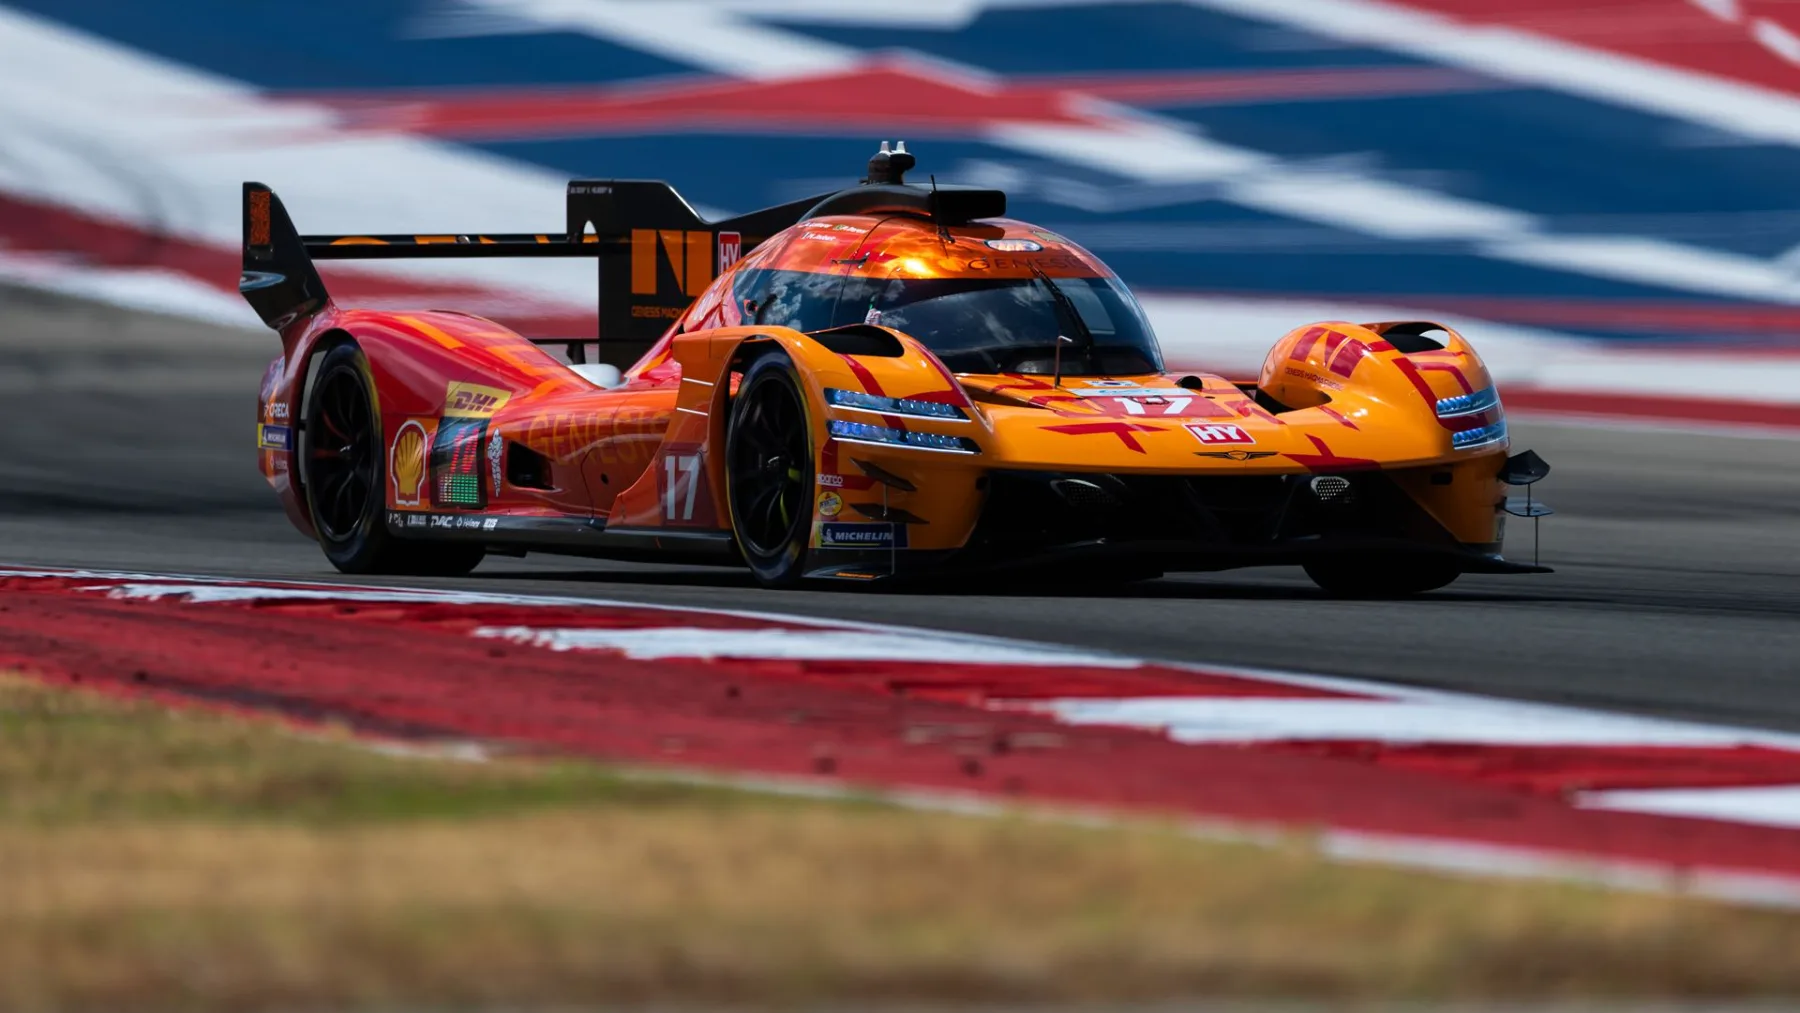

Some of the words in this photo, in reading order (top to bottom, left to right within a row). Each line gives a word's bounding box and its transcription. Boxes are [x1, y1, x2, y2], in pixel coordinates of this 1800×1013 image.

[968, 257, 1092, 271] GENESIS
[453, 391, 498, 412] DHL
[1112, 397, 1192, 414] 17
[269, 403, 289, 418] ORECA
[1191, 427, 1241, 441] HY
[665, 456, 700, 519] 17
[835, 532, 893, 540] MICHELIN
